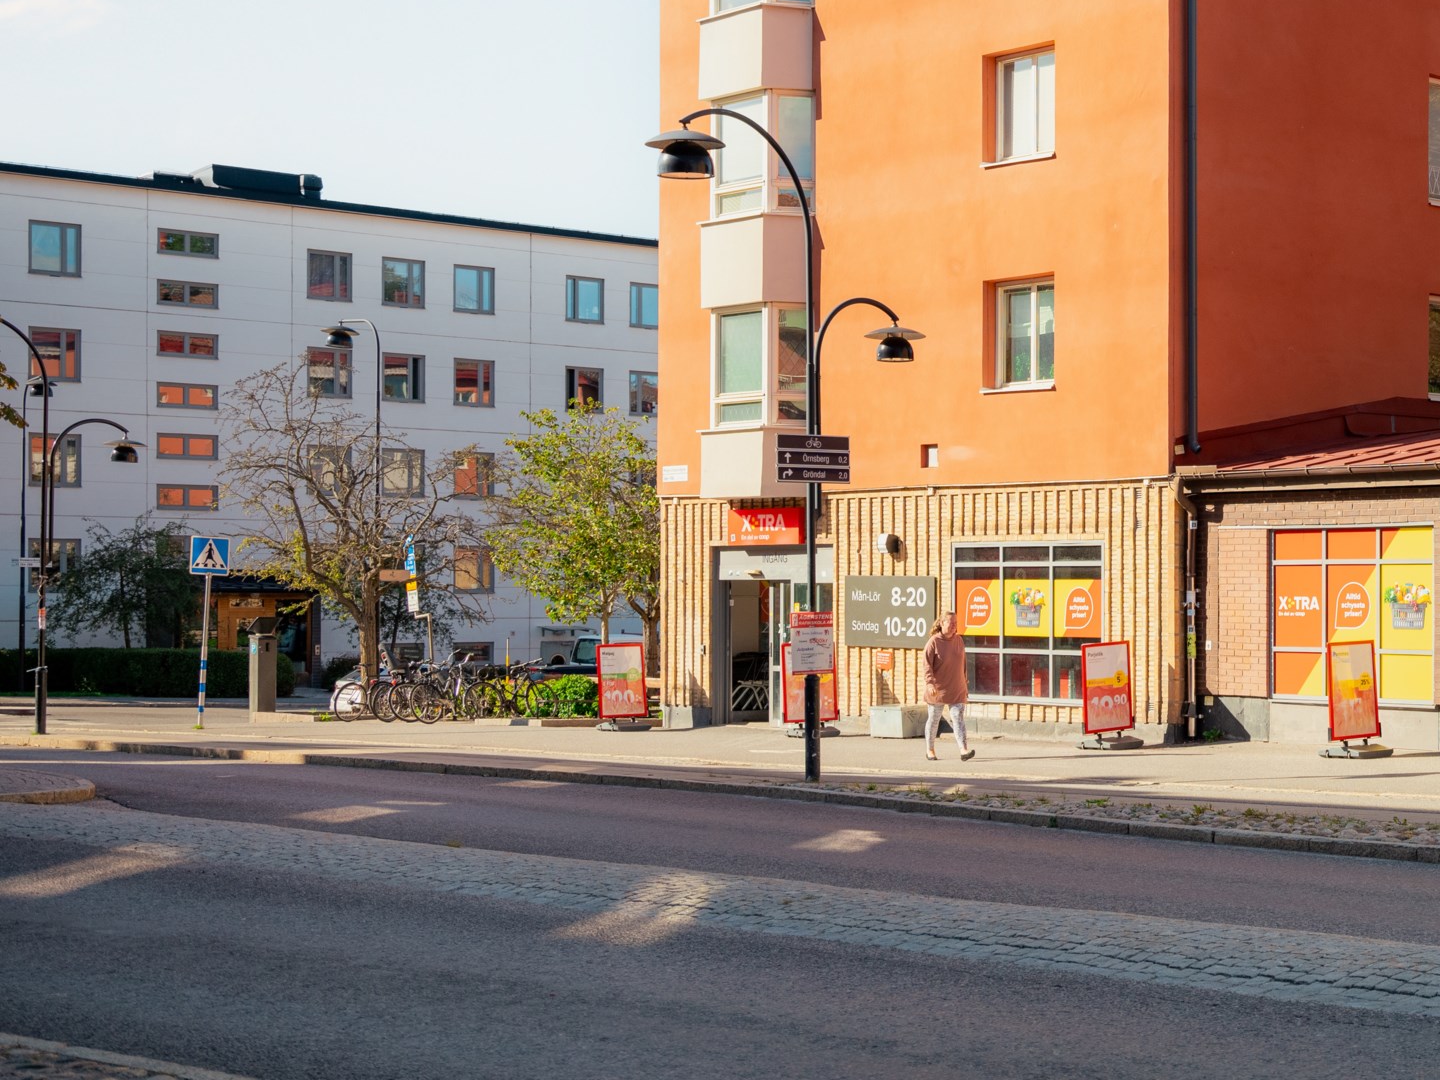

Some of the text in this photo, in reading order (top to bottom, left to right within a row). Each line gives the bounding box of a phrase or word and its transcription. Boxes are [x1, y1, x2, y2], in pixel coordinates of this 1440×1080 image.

[802, 453, 830, 464] Örnsberg
[803, 470, 848, 480] Gröndal 2,0
[762, 553, 788, 563] INGÅNG
[852, 586, 927, 607] Mån-Lör 8-20
[1341, 602, 1365, 610] schyssta
[1344, 610, 1362, 618] priser!
[852, 616, 927, 637] Söndag 10-20
